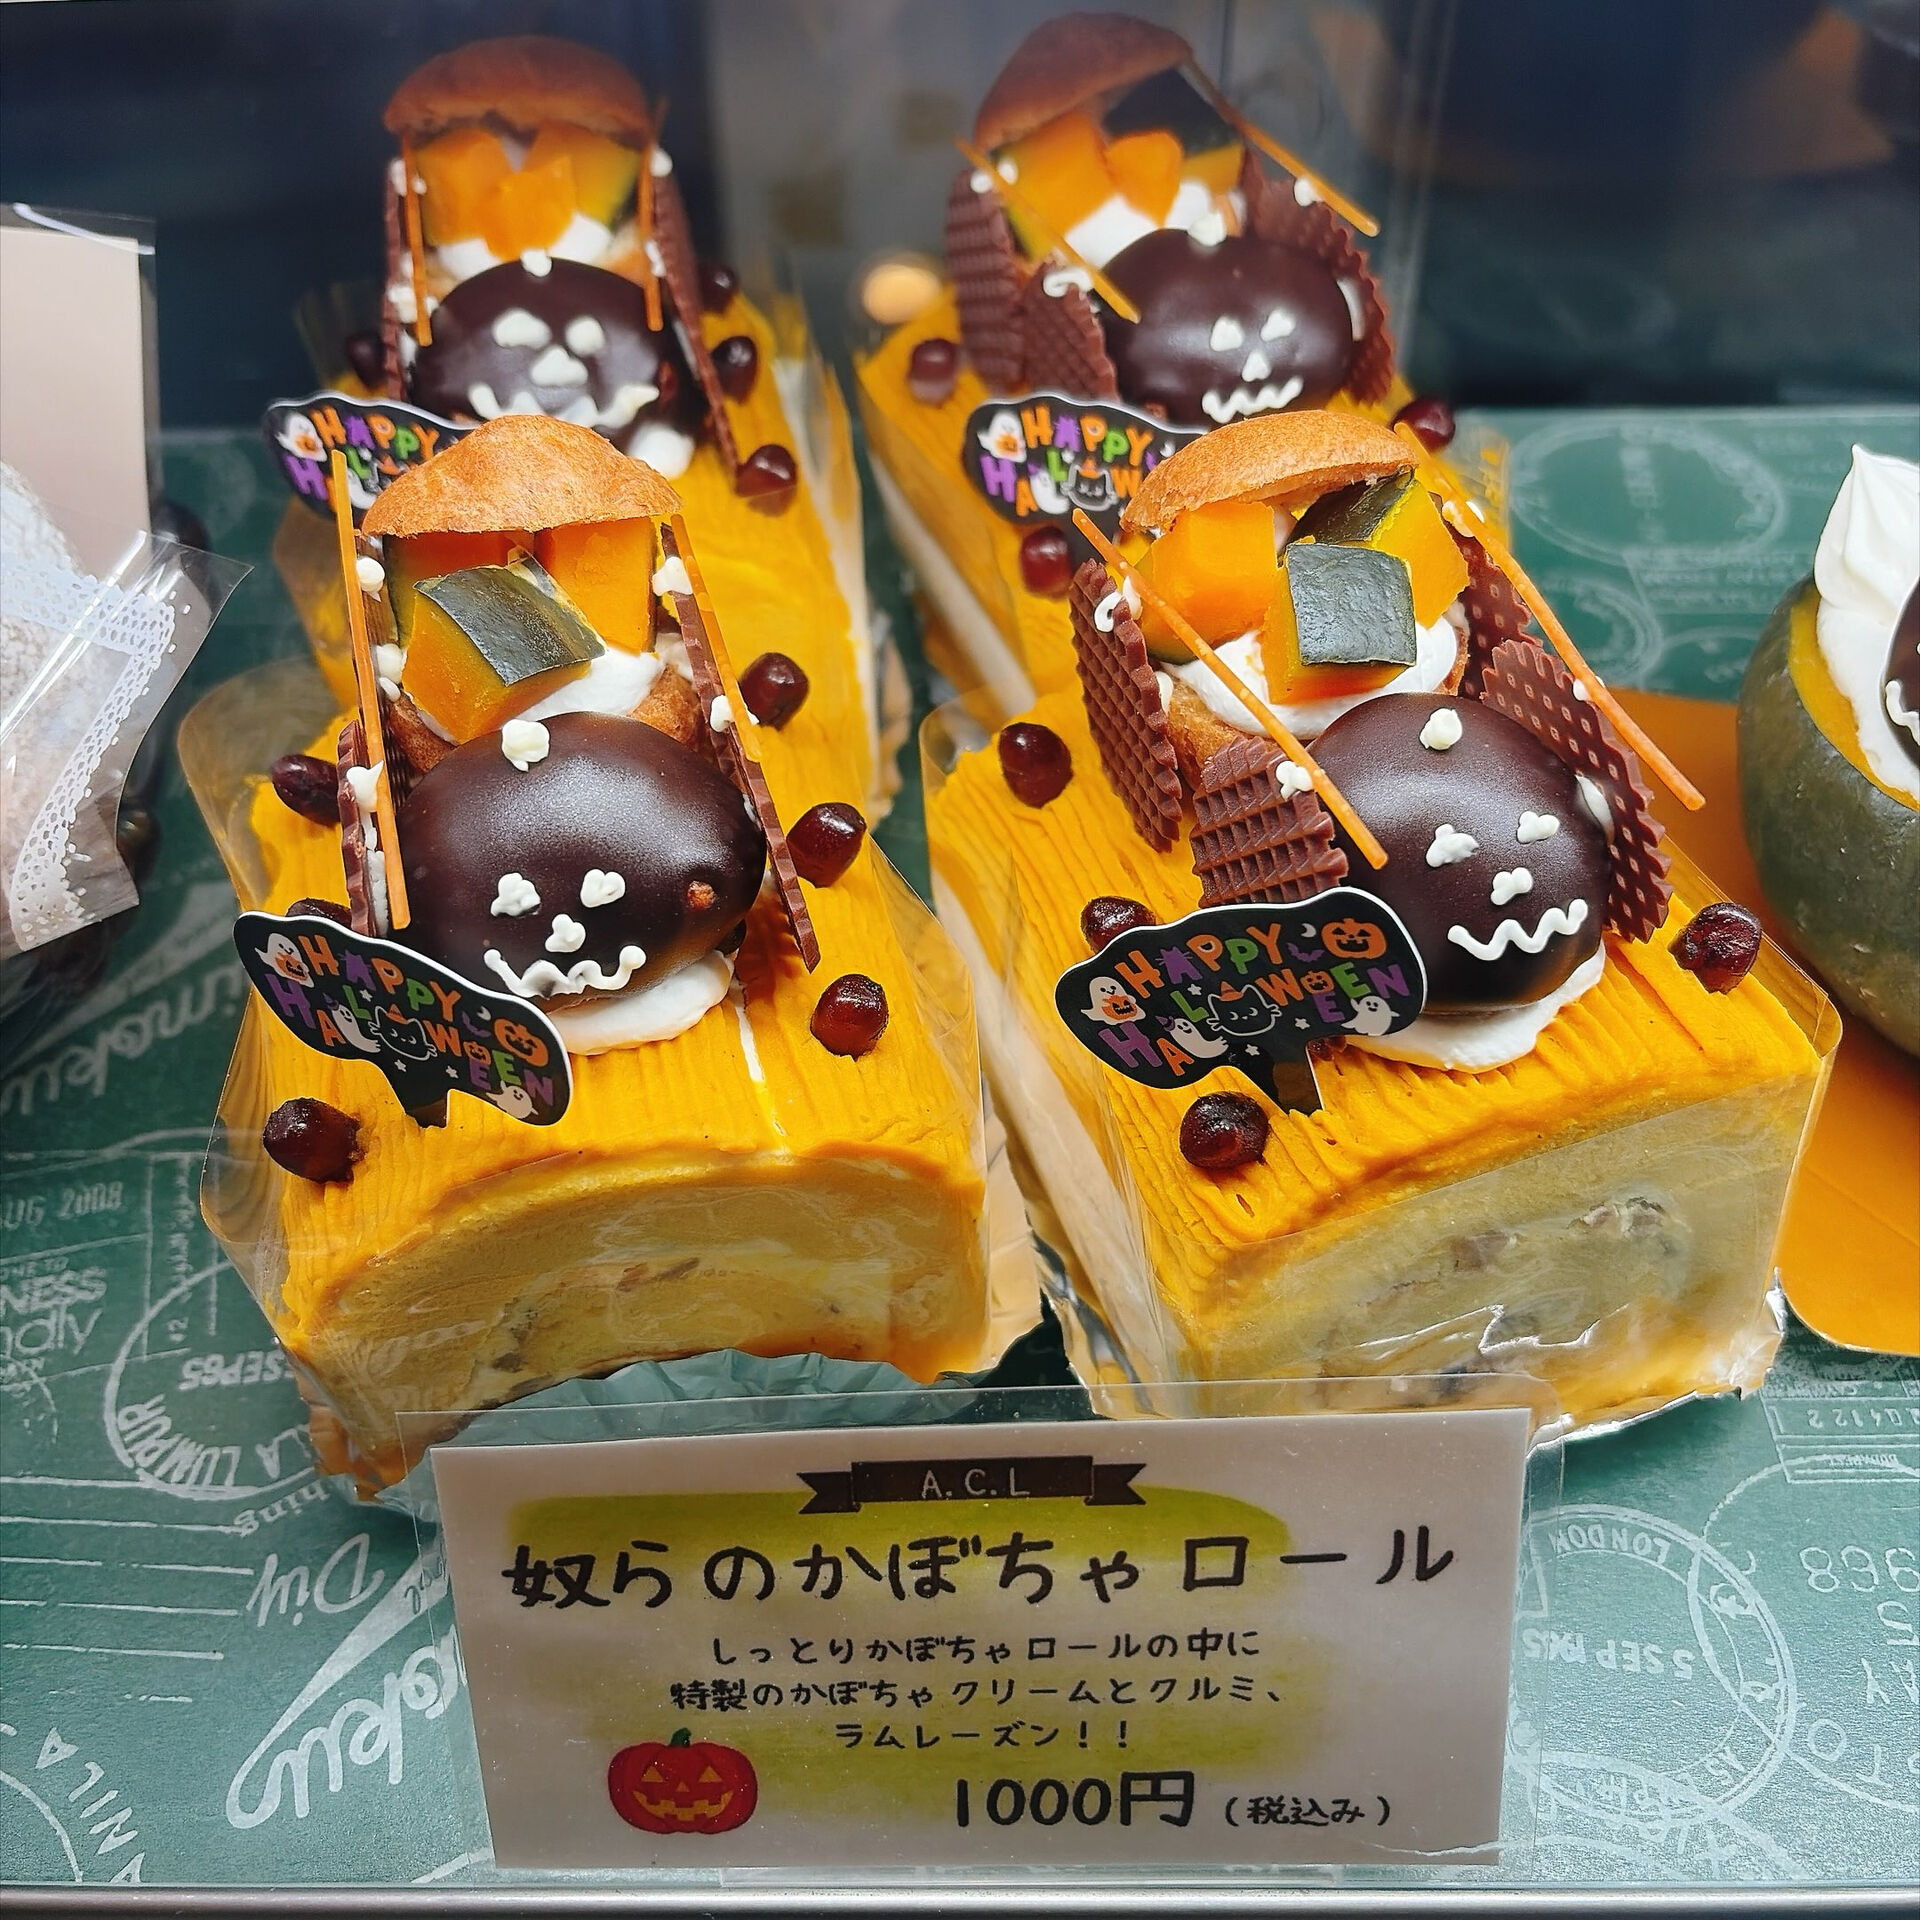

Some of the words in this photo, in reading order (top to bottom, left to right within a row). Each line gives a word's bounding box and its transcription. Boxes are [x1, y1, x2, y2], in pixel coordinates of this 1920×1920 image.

[308, 403, 440, 460] HAPPY
[1020, 403, 1153, 466] HAPPY
[297, 934, 461, 1023] HAPPY
[1114, 922, 1283, 999] HAPPY
[501, 1525, 1454, 1610] 奴らのかぼちゃロール
[1548, 1523, 1672, 1564] LONDON
[247, 1532, 384, 1627] Diy
[712, 1626, 1260, 1665] しっとりかぼちゃロールの中に
[1595, 1639, 1665, 1674] SEP
[956, 1770, 1195, 1828] 1000円
